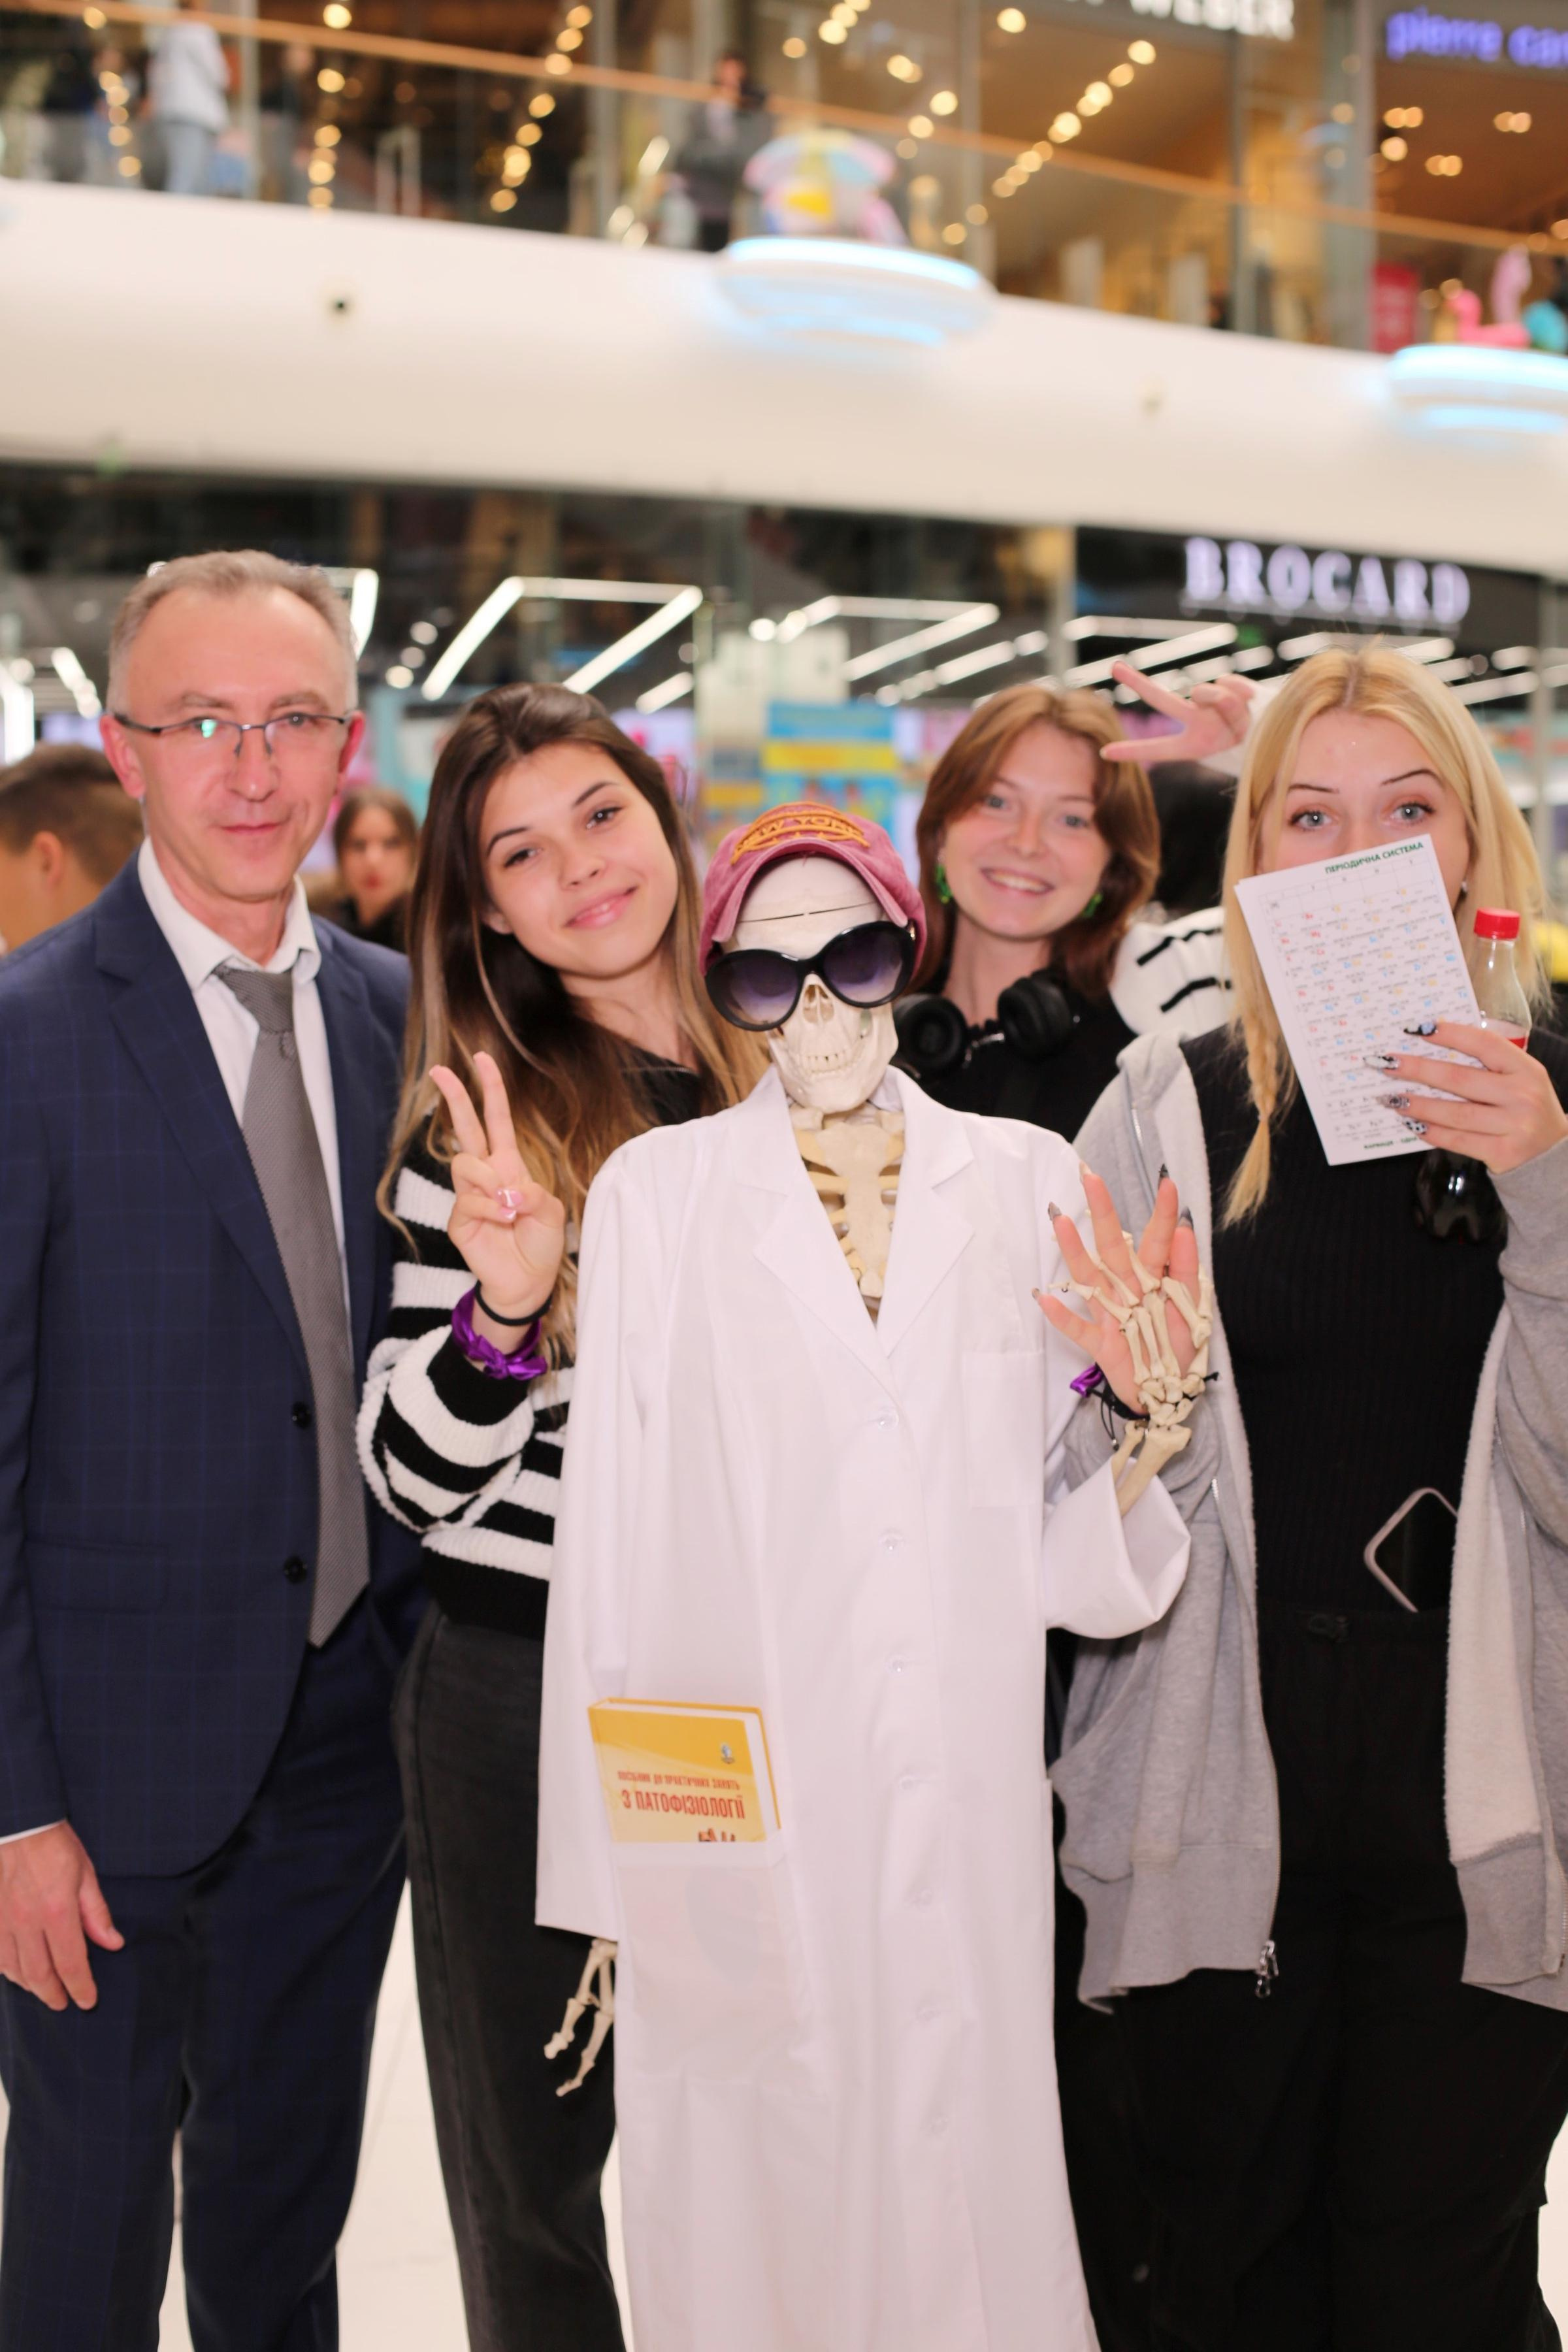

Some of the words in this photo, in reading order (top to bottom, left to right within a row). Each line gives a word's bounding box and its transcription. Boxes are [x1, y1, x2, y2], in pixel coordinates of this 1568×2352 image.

[1385, 5, 1502, 63] pierre
[1185, 536, 1470, 624] BROCARD
[1325, 853, 1381, 874] ПЕРІОДИЧНА
[1382, 841, 1424, 859] СИСТЕМА
[635, 1790, 745, 1820] ПАТОФІЗІОЛОГІЇ
